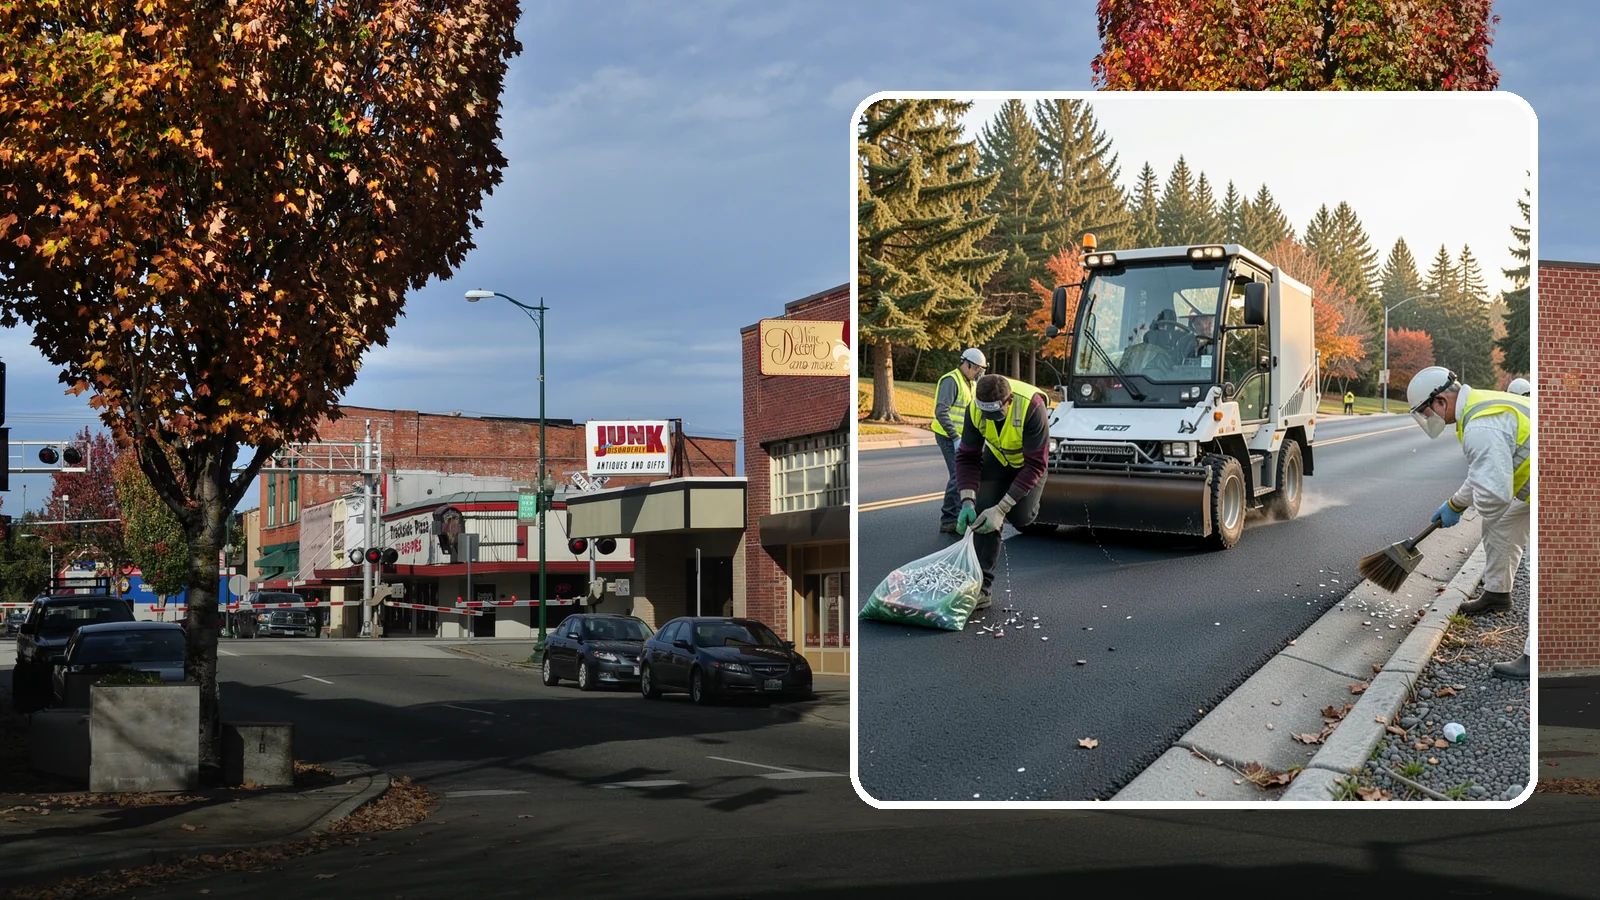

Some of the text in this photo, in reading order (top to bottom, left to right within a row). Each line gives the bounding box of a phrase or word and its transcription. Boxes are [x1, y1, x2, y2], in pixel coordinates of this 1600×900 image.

[596, 425, 664, 457] JUNK
[608, 446, 645, 454] DISORDERLY
[597, 460, 665, 470] ANTIQUES AND GIFTS
[352, 498, 364, 511] CRO
[391, 519, 429, 539] Trackside Pizza
